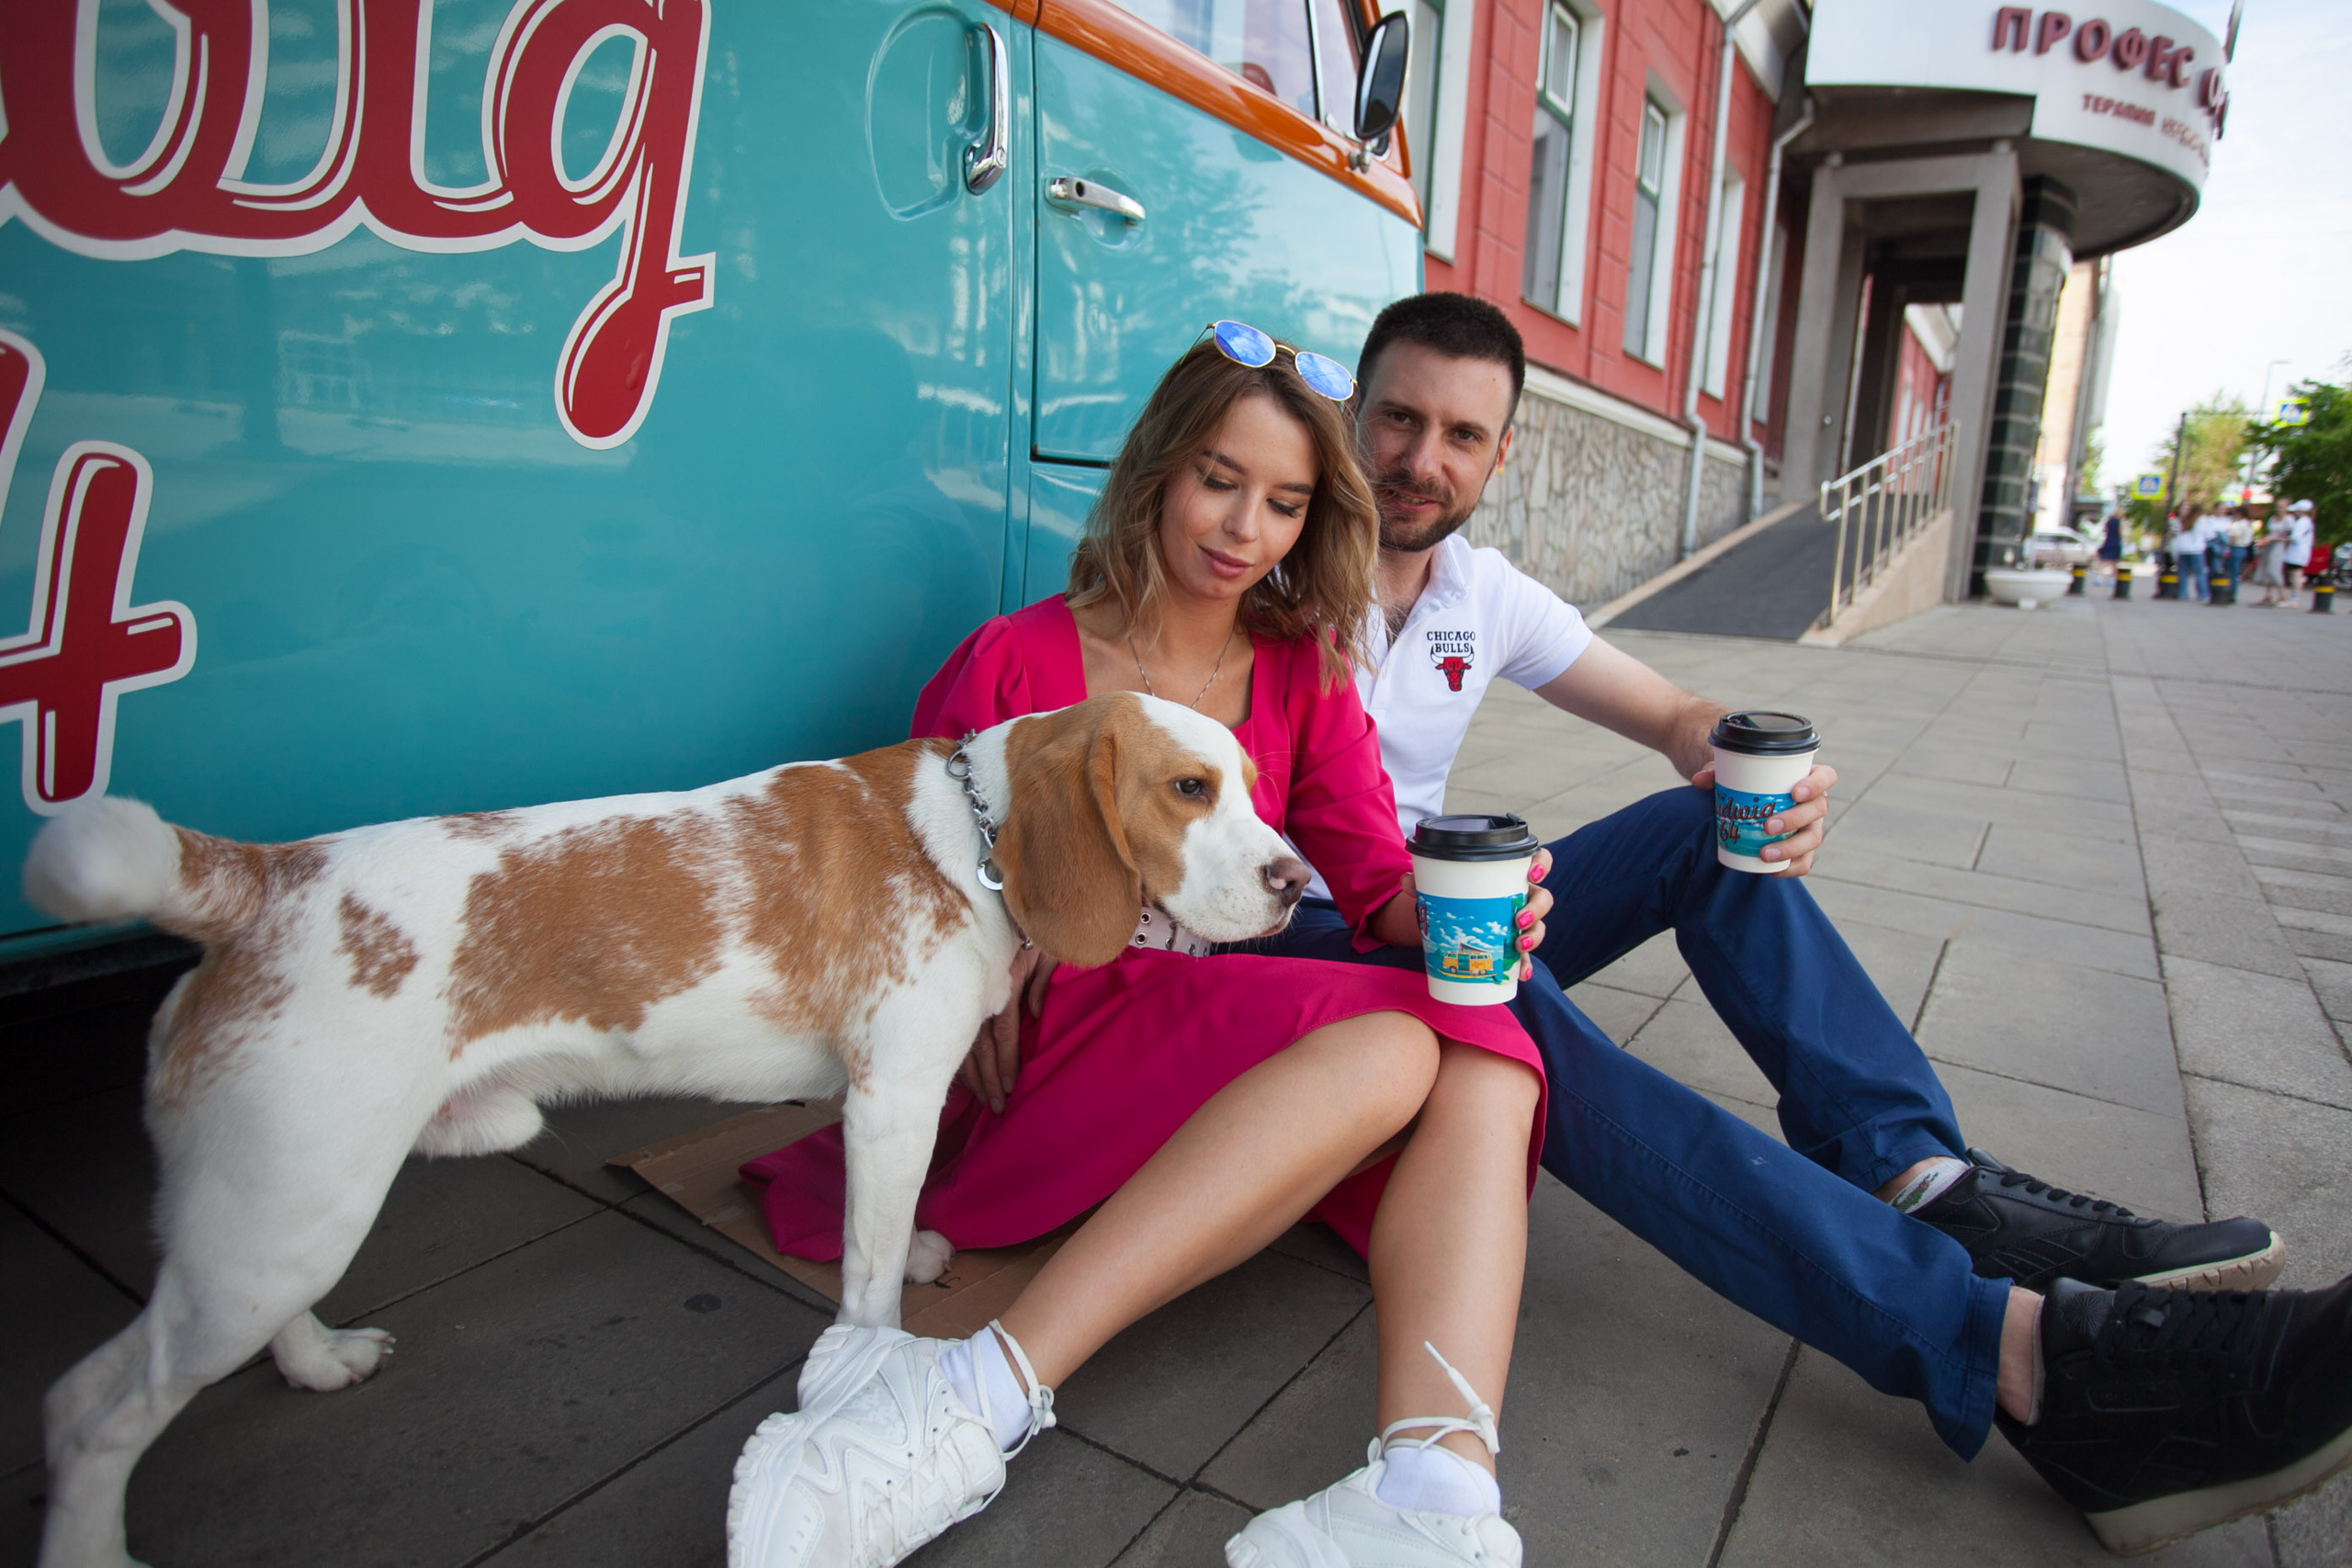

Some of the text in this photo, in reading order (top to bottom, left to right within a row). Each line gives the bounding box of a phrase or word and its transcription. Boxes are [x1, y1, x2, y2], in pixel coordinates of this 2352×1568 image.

[1427, 630, 1476, 641] CHICAGO
[1435, 643, 1470, 653] BULLS
[1719, 819, 1740, 843] 64
